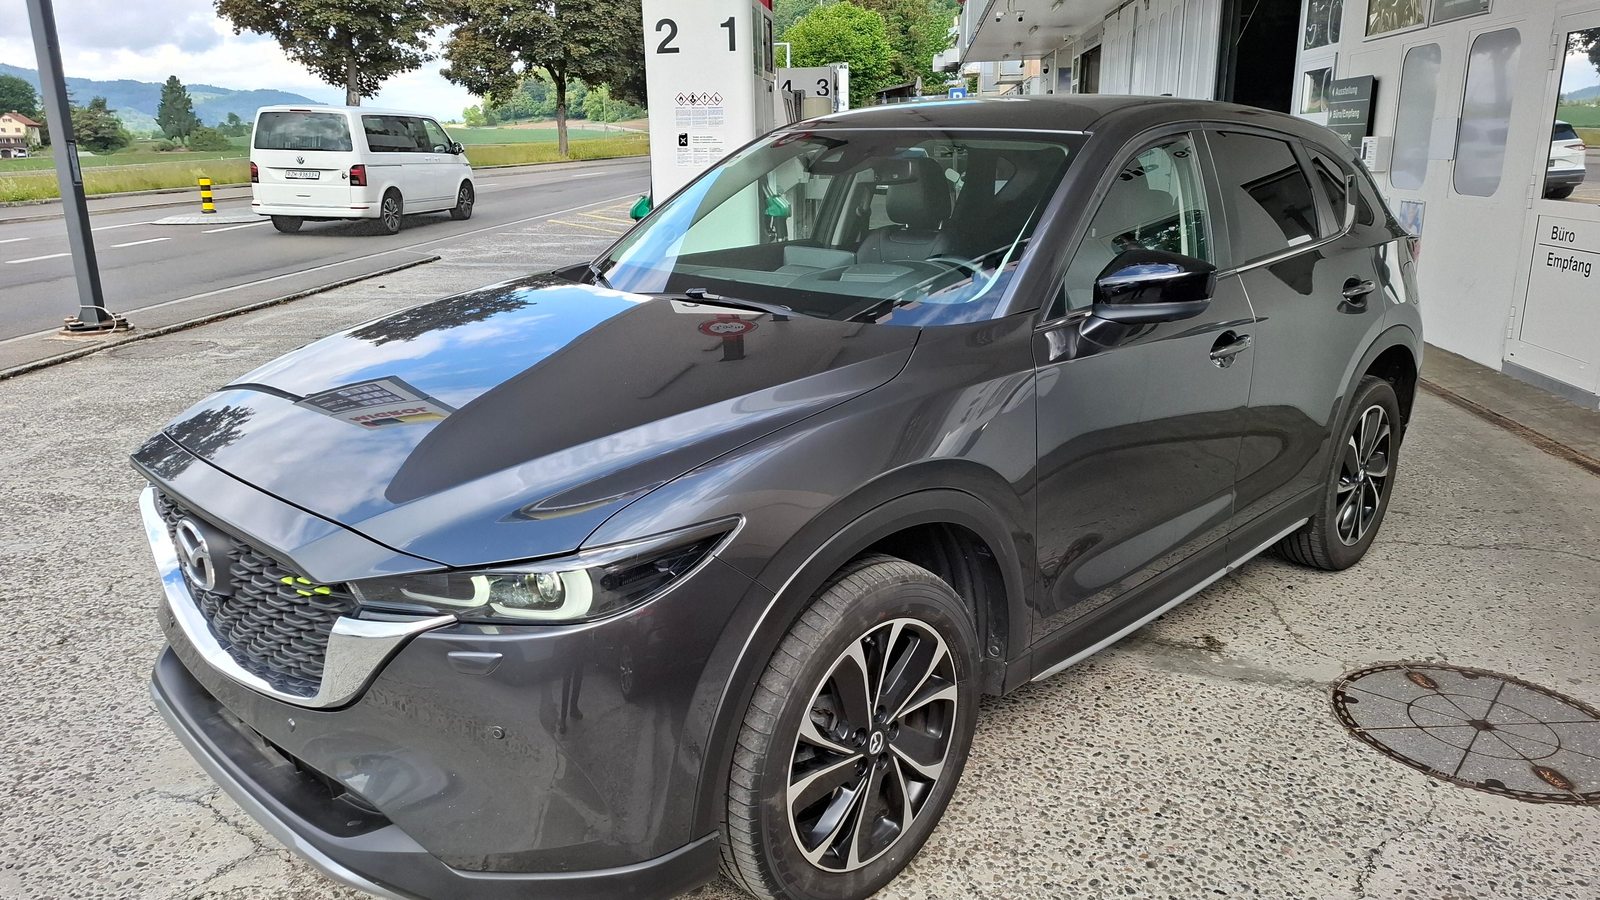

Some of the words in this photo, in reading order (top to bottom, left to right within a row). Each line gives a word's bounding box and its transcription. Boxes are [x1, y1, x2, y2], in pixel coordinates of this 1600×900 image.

[655, 18, 680, 54] 2
[720, 16, 736, 51] 1
[816, 78, 830, 96] 3
[1551, 226, 1575, 243] Büro
[1547, 252, 1592, 278] Empfang
